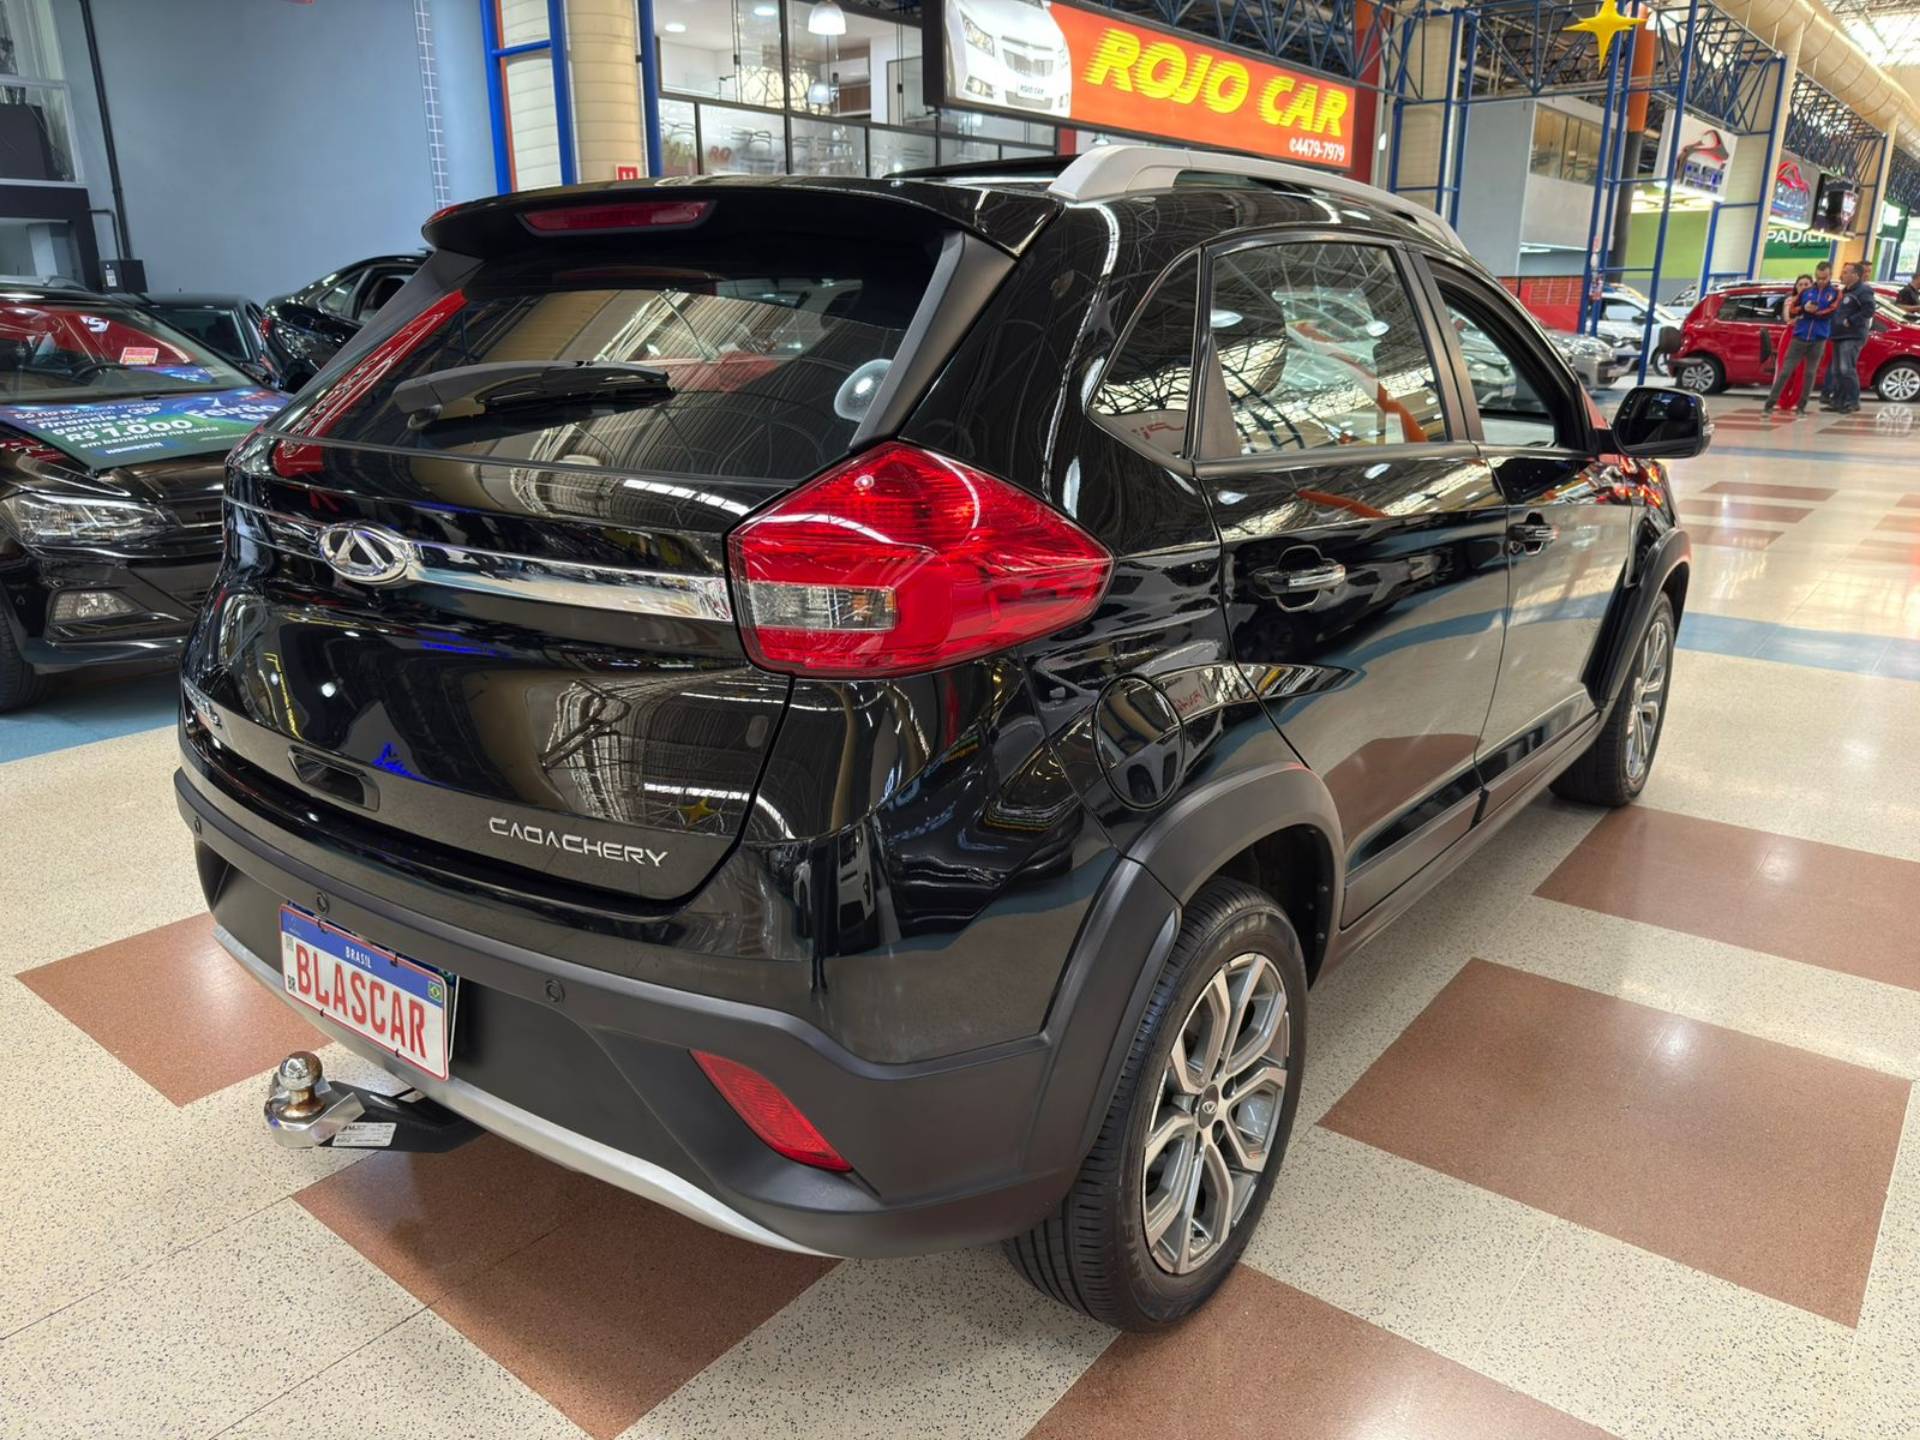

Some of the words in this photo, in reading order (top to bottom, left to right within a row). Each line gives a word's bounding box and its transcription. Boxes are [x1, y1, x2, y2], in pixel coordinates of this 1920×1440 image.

[1084, 27, 1249, 114] ROJO
[1257, 76, 1348, 137] CAR
[1296, 138, 1345, 162] 4479-7979
[51, 421, 113, 436] ganhe
[65, 430, 99, 442] R$
[102, 419, 193, 438] 1.000
[345, 946, 372, 969] BRASIL
[296, 943, 427, 1059] BLASCAR
